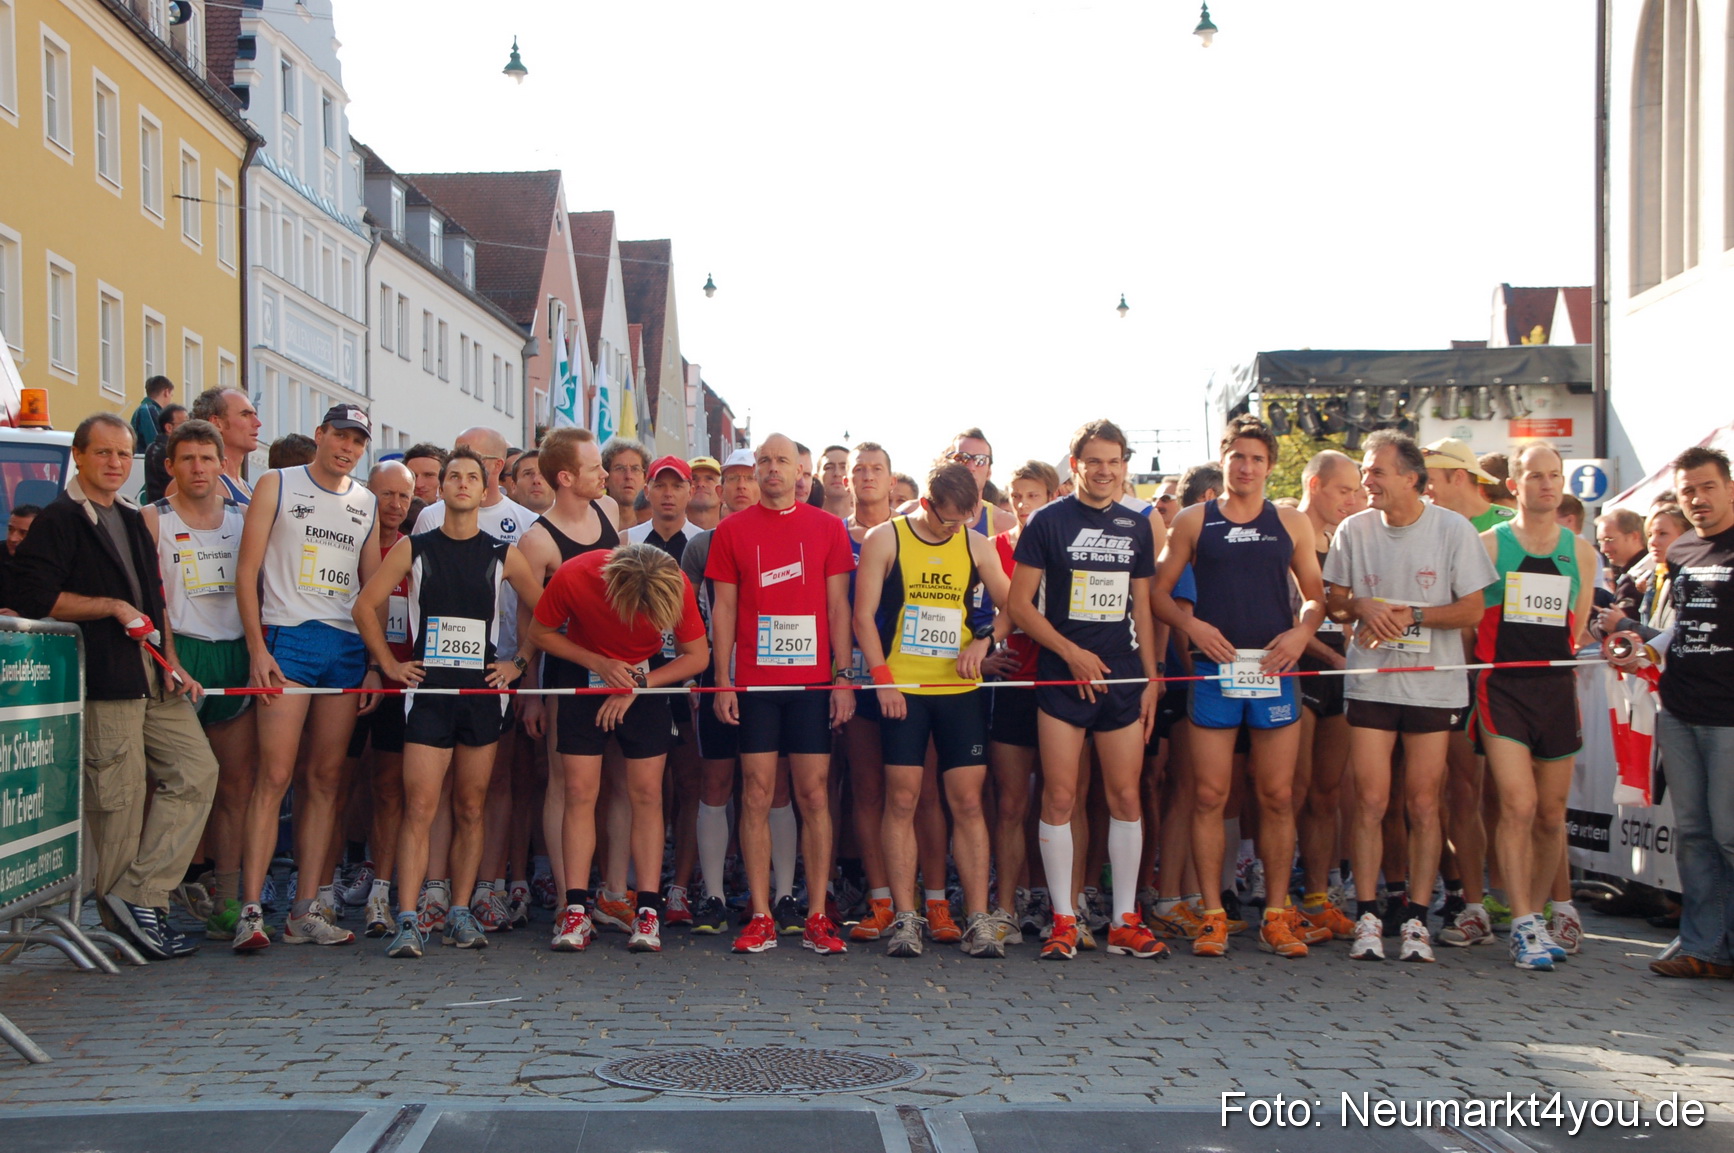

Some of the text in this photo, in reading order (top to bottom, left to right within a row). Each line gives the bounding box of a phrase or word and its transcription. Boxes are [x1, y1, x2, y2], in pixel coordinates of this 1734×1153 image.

[305, 525, 355, 547] ERDINGER
[1084, 537, 1131, 550] NAGEL
[197, 550, 232, 561] Christian
[1072, 552, 1130, 564] SC Roth 52
[217, 566, 225, 579] 1
[319, 568, 350, 586] 1066
[772, 569, 791, 580] DEHN
[921, 572, 952, 585] LRC
[1089, 576, 1114, 586] Dorian
[909, 591, 961, 602] NAUNDORF
[1090, 594, 1123, 607] 1021
[1525, 595, 1562, 610] 1089
[921, 611, 946, 622] Martin
[441, 621, 467, 632] Marco
[773, 620, 799, 630] Rainer
[920, 628, 957, 645] 2600
[441, 639, 481, 655] 2862
[775, 637, 813, 652] 2507
[14, 729, 55, 771] Sicherheit
[2, 783, 45, 828] Ihr Event!
